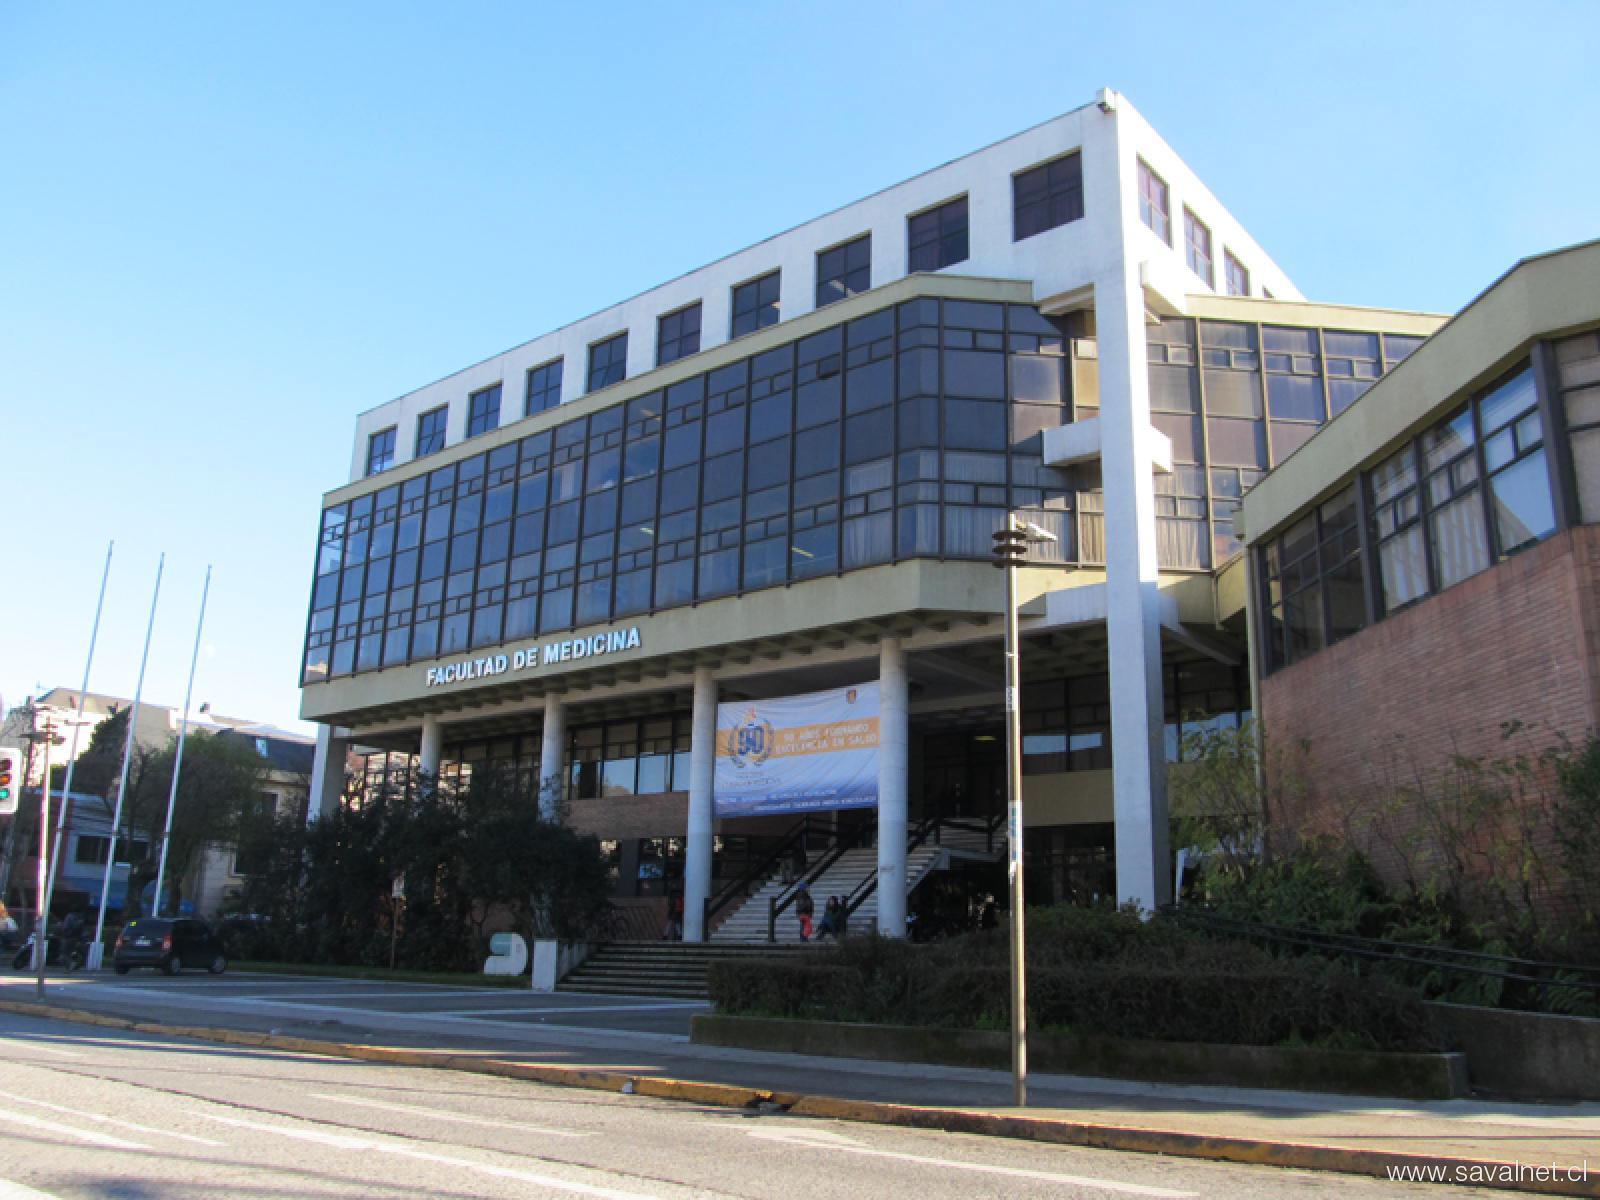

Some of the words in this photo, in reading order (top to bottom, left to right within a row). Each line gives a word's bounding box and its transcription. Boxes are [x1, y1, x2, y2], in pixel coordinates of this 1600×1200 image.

[426, 655, 508, 686] FACULTAD
[513, 648, 539, 670] DE
[544, 626, 642, 664] MEDICINA
